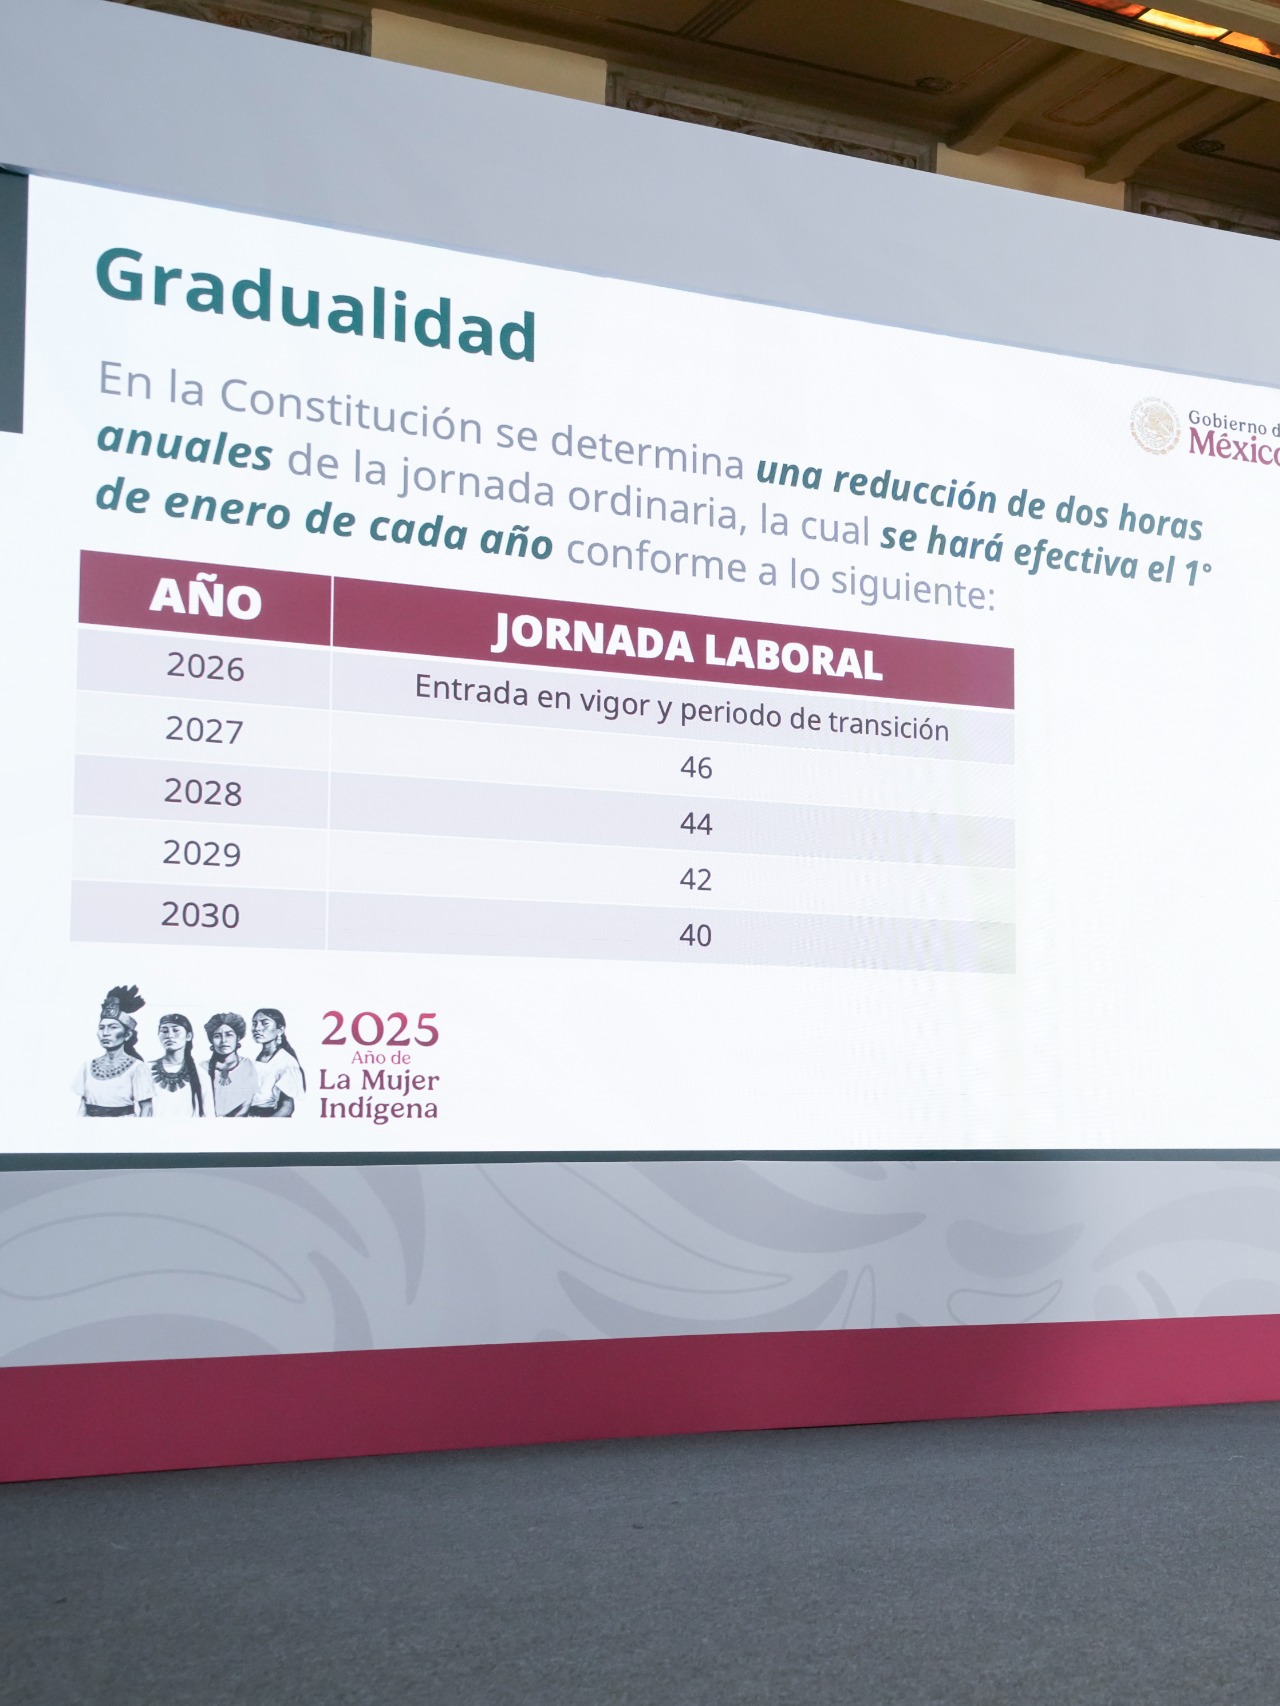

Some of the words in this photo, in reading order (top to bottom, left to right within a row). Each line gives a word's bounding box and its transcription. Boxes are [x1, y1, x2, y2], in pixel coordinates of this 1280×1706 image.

[96, 248, 535, 363] Gradualidad
[1189, 410, 1267, 435] Gobierno
[100, 360, 151, 400] En
[170, 367, 203, 407] la
[221, 379, 482, 445] Constitución
[496, 424, 538, 452] se
[551, 424, 744, 480] determina
[756, 459, 823, 491] una
[833, 468, 997, 514] reducción
[1007, 488, 1046, 521] de
[1055, 494, 1110, 529] dos
[1118, 502, 1204, 542] horas
[96, 426, 274, 472] anuales
[288, 442, 339, 480] de
[354, 448, 386, 486] la
[395, 457, 554, 508] jornada
[568, 484, 747, 537] ordinaria,
[761, 502, 788, 537] la
[801, 515, 869, 547] cual
[880, 526, 918, 552] se
[926, 524, 1004, 563] hará
[1013, 539, 1139, 580] efectiva
[1147, 554, 1176, 584] el
[96, 475, 151, 514] de
[164, 492, 291, 530] enero
[305, 500, 357, 538] de
[369, 514, 469, 551] cada
[480, 524, 554, 561] año
[567, 538, 747, 583] conforme
[758, 562, 777, 587] a
[791, 557, 820, 591] lo
[831, 563, 995, 610] siguiente:
[148, 572, 262, 621] AÑO
[491, 612, 694, 663] JORNADA
[704, 633, 884, 682] LABORAL
[166, 651, 245, 682] 2026
[416, 673, 528, 707] Entrada
[537, 689, 571, 710] en
[580, 690, 651, 721] vigor
[656, 700, 673, 725] y
[681, 699, 782, 728] periodo
[789, 706, 822, 732] de
[828, 711, 949, 742] transición
[165, 715, 244, 745] 2027
[680, 755, 713, 780] 46
[163, 777, 243, 807] 2028
[679, 811, 714, 836] 44
[162, 839, 241, 868] 2029
[679, 867, 713, 892] 42
[160, 900, 240, 930] 2030
[679, 923, 713, 948] 40
[321, 1010, 440, 1047] 2025
[351, 1050, 387, 1065] Año
[390, 1050, 411, 1065] de
[319, 1069, 351, 1091] La
[361, 1069, 441, 1096] Mujer
[319, 1096, 438, 1126] Indígena
